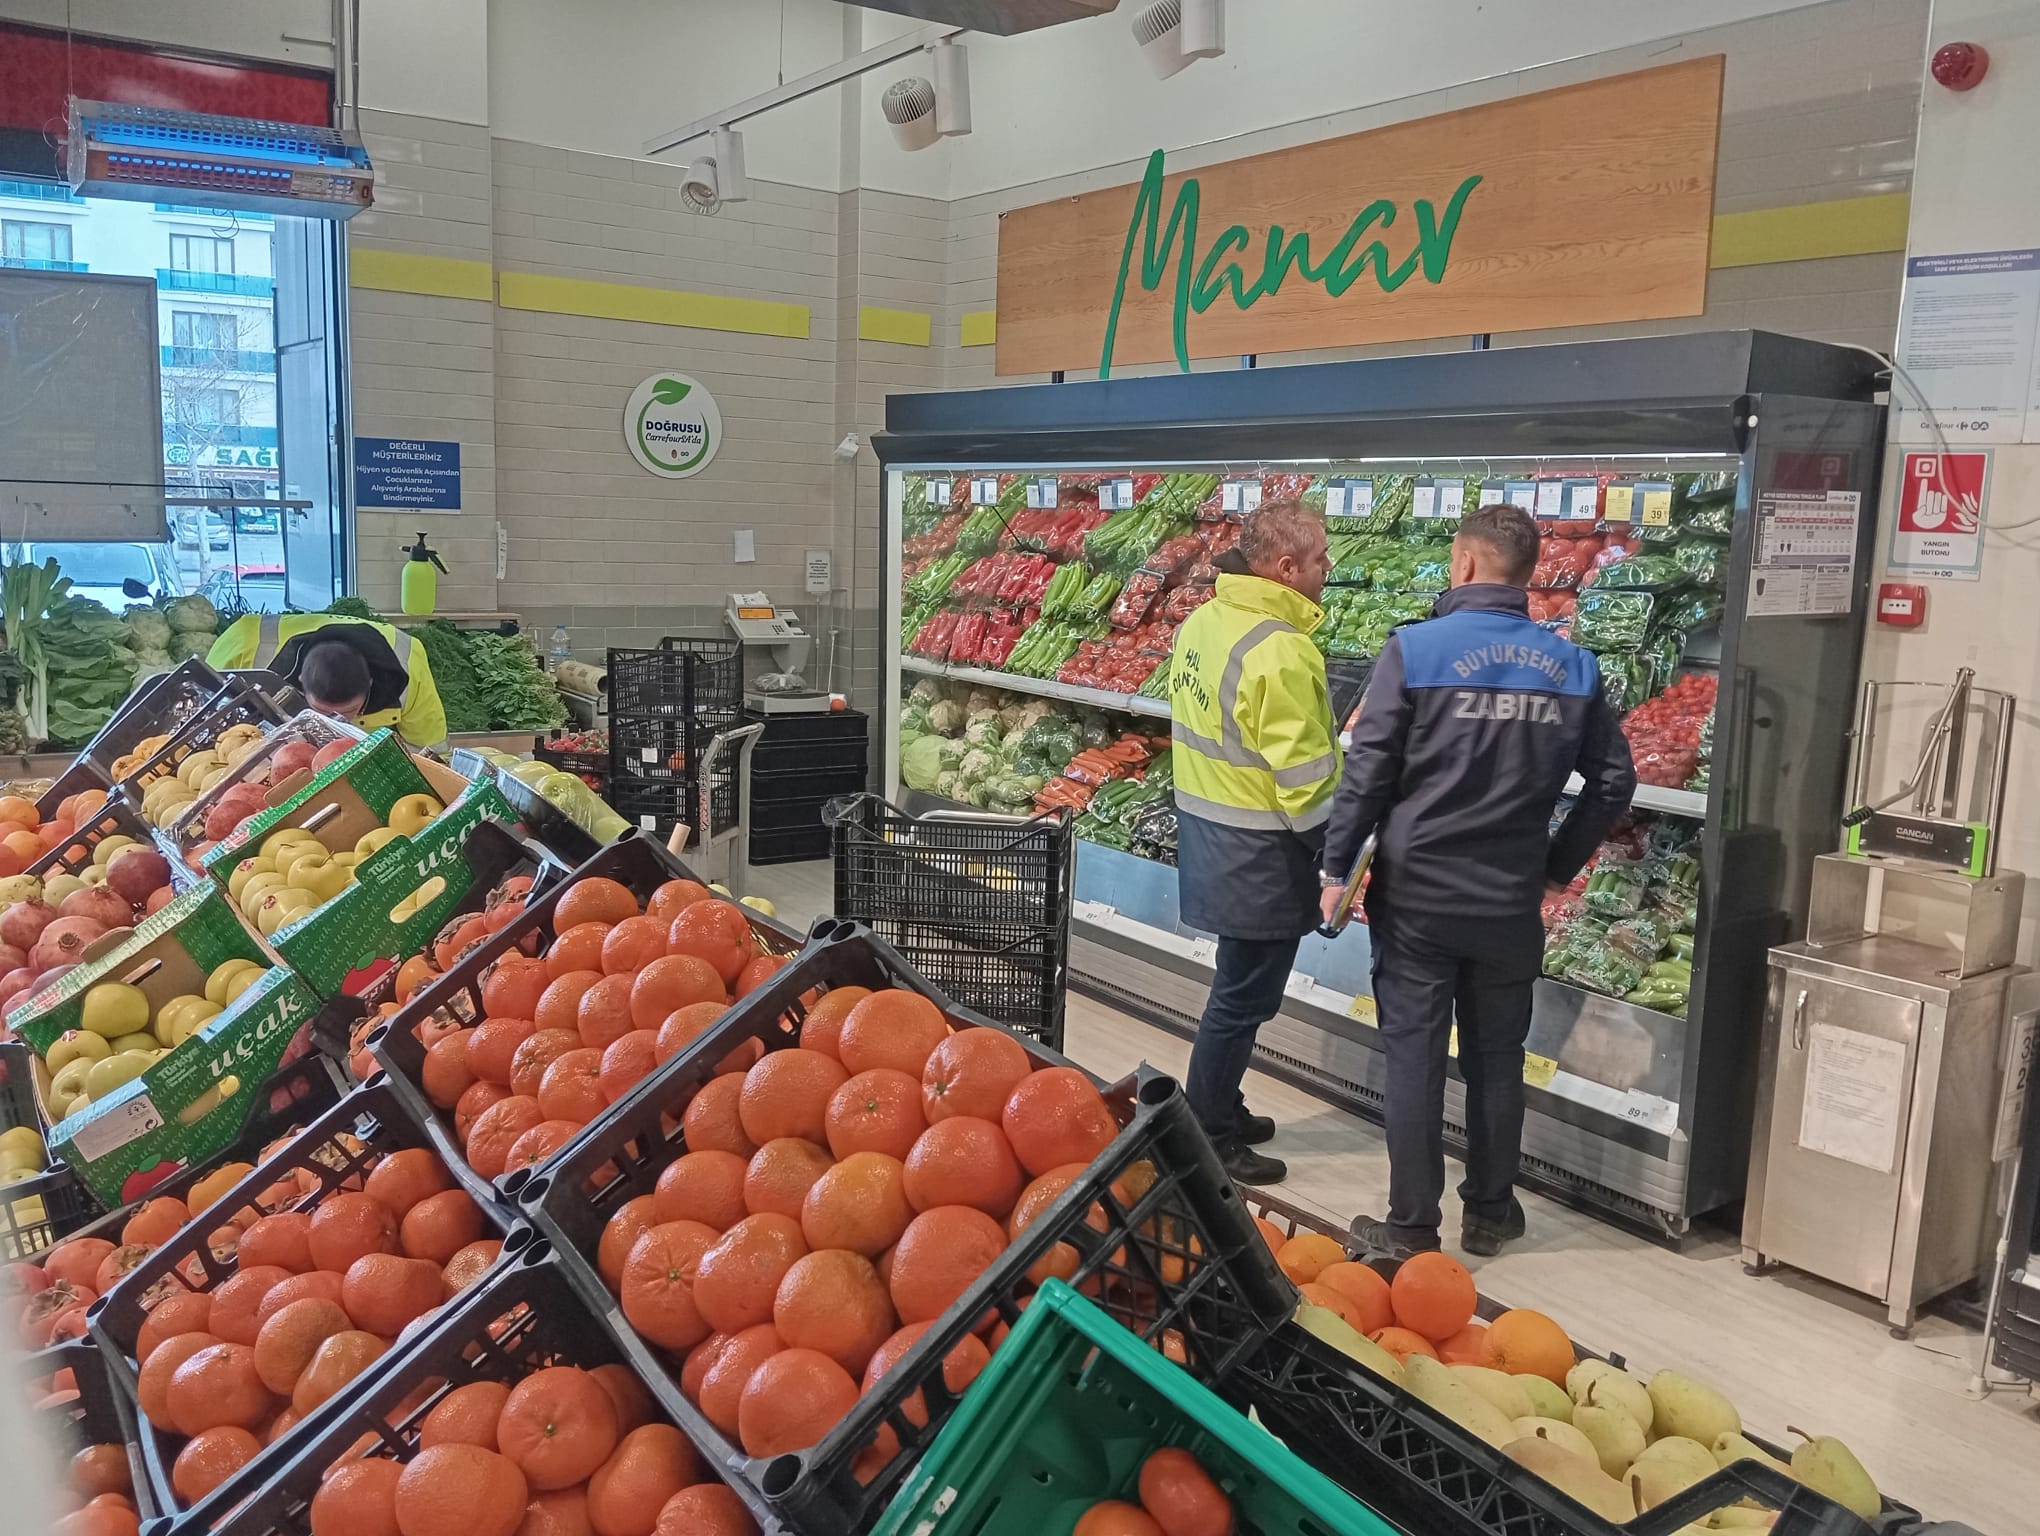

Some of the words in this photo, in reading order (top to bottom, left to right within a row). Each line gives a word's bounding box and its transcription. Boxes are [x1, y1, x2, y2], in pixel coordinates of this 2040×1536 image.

[1099, 148, 1483, 380] Manav
[645, 420, 702, 434] DOĞRUSU
[389, 441, 426, 451] DEĞERLİ
[372, 450, 442, 462] MÜŞTERİLERİMİZ
[356, 465, 380, 474] Hijyen
[391, 466, 423, 475] Güvenlik
[1578, 504, 1589, 514] 49
[1650, 510, 1662, 520] 39
[1923, 540, 1950, 548] YANGIN
[1920, 549, 1950, 557] BUTONU
[1185, 648, 1201, 673] HAL
[1452, 640, 1568, 688] BÜYÜKŞEHİR
[1454, 691, 1563, 725] ZABITA
[1896, 826, 1935, 841] CANCAN
[207, 989, 302, 1077] uçak
[1627, 1107, 1641, 1118] 89
